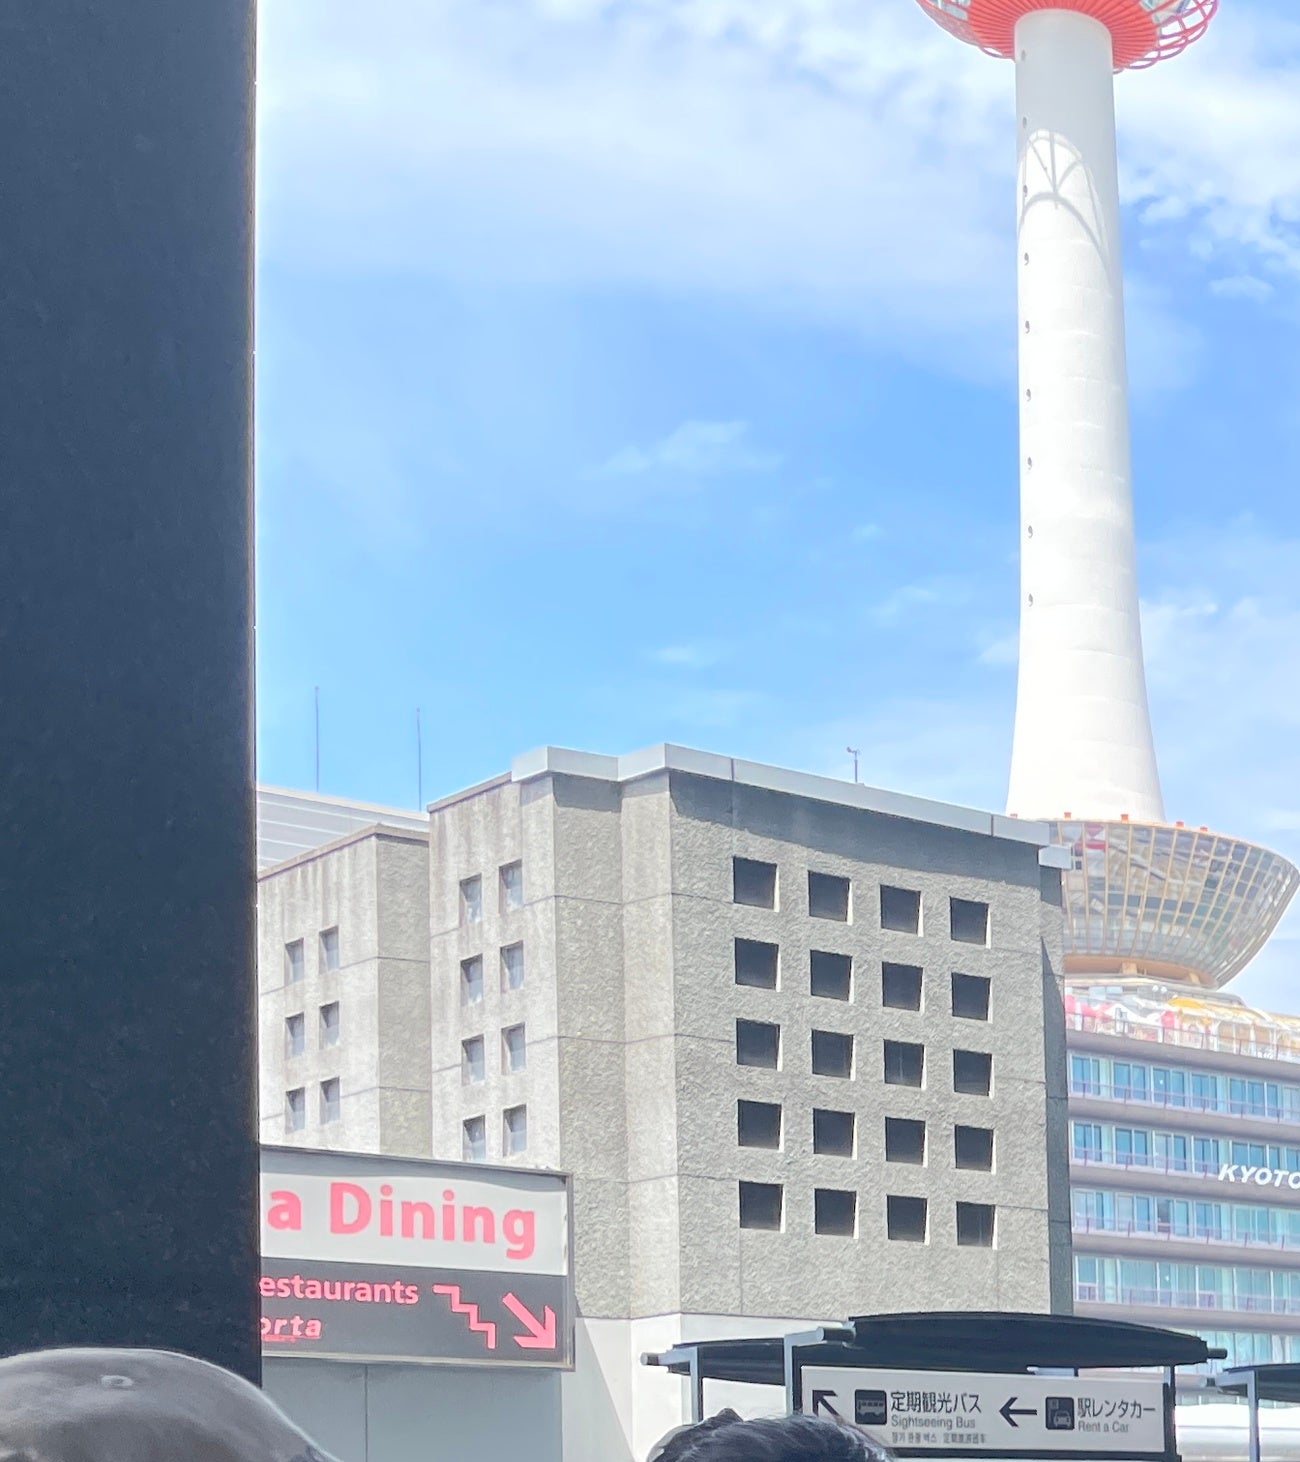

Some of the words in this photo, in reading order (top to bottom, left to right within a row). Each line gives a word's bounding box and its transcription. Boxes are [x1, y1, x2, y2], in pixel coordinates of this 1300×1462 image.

[330, 1182, 535, 1261] Dining
[890, 1390, 982, 1414] 定期観光バス
[1077, 1397, 1156, 1419] 駅レンタカー
[891, 1416, 953, 1430] Sightseeing
[956, 1417, 976, 1428] Bus
[1078, 1420, 1101, 1432] Rent
[1103, 1423, 1110, 1432] a
[1111, 1421, 1130, 1433] Car
